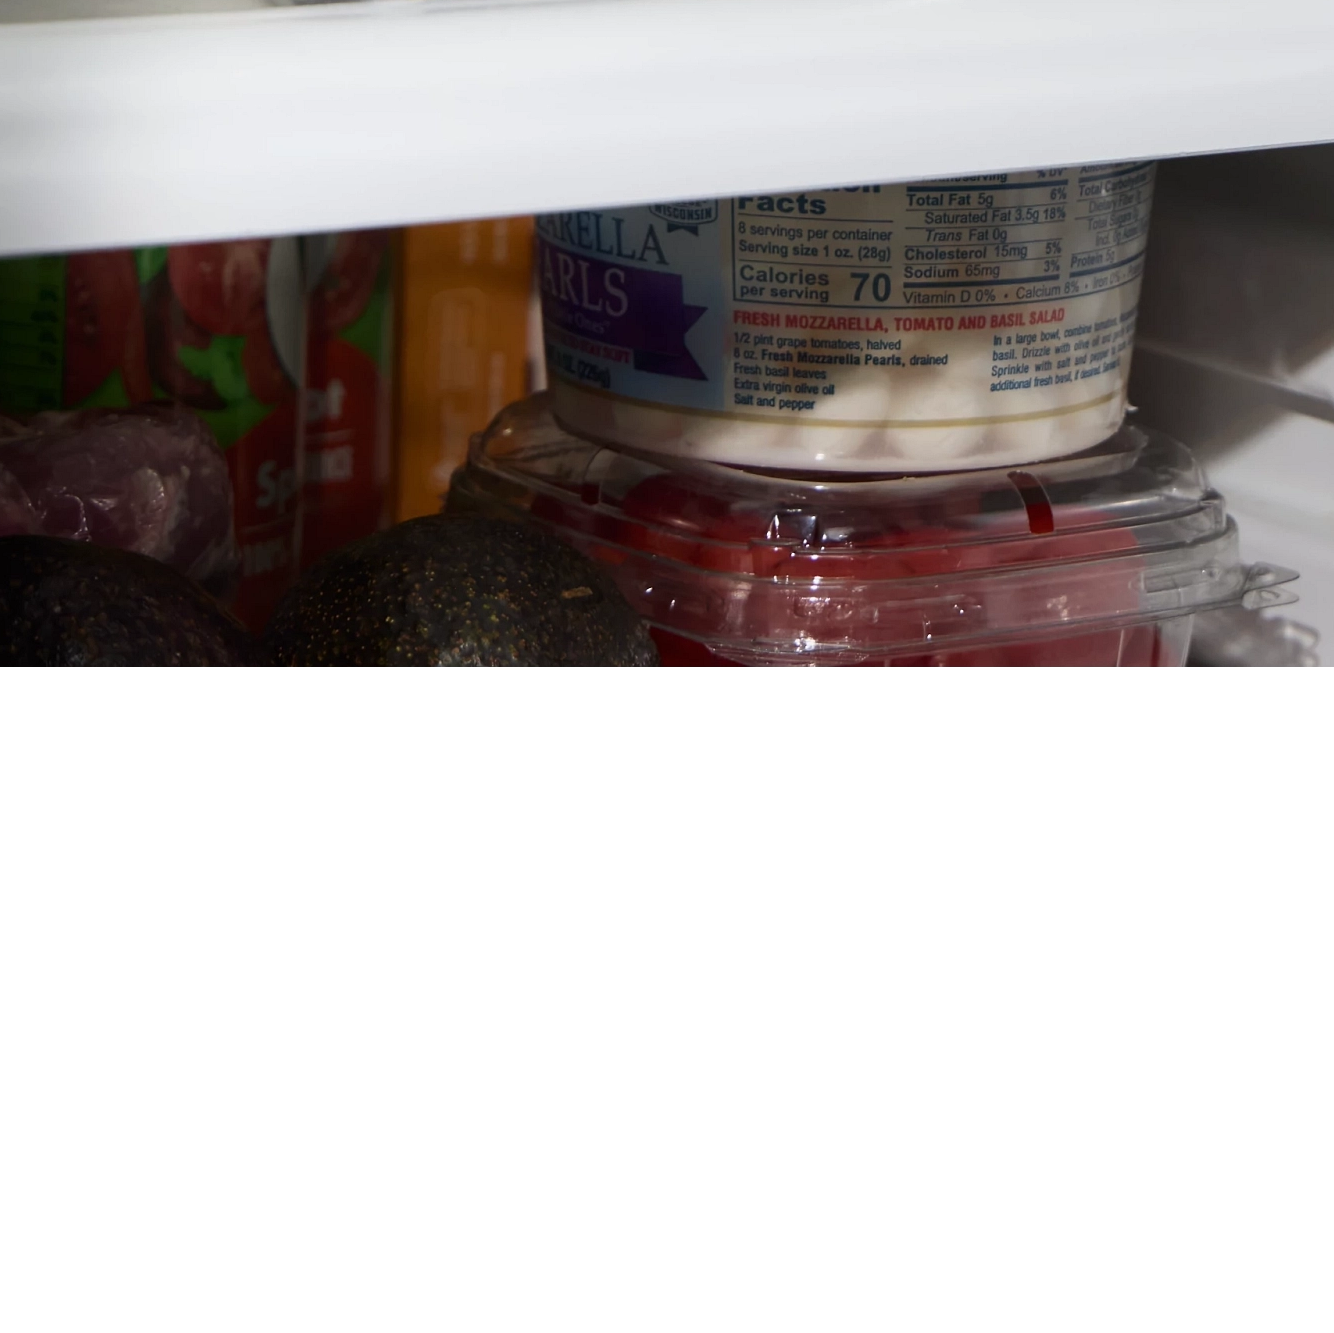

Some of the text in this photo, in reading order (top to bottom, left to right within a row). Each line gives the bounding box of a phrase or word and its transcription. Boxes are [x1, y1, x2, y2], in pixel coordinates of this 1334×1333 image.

[906, 188, 1067, 208] Total Fat 5g 6%
[1079, 185, 1102, 197] Total
[655, 205, 712, 220] WISCONSIN
[925, 206, 1066, 224] Saturated Fat 3.5g 18%
[739, 221, 893, 242] 8 servings per container
[925, 228, 1007, 243] Trans Fat 0g
[739, 240, 891, 262] Serving size 1 oz. (28g)
[904, 242, 1062, 261] Cholesterol 15mg 5%
[1070, 253, 1103, 268] Protein
[740, 265, 829, 285] Calories
[903, 259, 1060, 278] Sodium 65mg 3%
[740, 285, 829, 303] per serving
[850, 272, 891, 302] 70
[903, 291, 956, 304] Vitamin
[960, 291, 971, 303] D
[975, 289, 996, 303] 0%
[1016, 286, 1061, 300] Calcium
[1064, 280, 1079, 294] 8%
[733, 307, 1065, 333] FRESH MOZZARELLA, TOMATO AND BASIL SALAD
[733, 332, 901, 351] 1/2 pint grape tomatoes, halved
[993, 335, 1002, 346] In
[1006, 336, 1012, 345] a
[1016, 332, 1037, 346] large
[1041, 329, 1061, 342] bowl,
[1064, 324, 1092, 338] combine
[743, 351, 757, 360] oz.
[761, 349, 793, 362] Fresh
[797, 351, 860, 365] Mozzarella
[864, 353, 905, 367] Pearls,
[910, 354, 948, 366] drained
[992, 349, 1017, 361] basil.
[1022, 347, 1050, 359] Drizzle
[1055, 343, 1070, 354] with
[1074, 339, 1089, 351] olive
[734, 363, 827, 379] Fresh basil leaves
[991, 364, 1029, 378] Sprinkle
[1035, 361, 1052, 373] with
[1057, 358, 1070, 369] salt
[1074, 354, 1087, 366] and
[734, 378, 835, 395] Extra virgin olive oil
[990, 378, 1031, 392] additional
[1034, 375, 1053, 387] fresh
[734, 393, 815, 411] Salt and pepper
